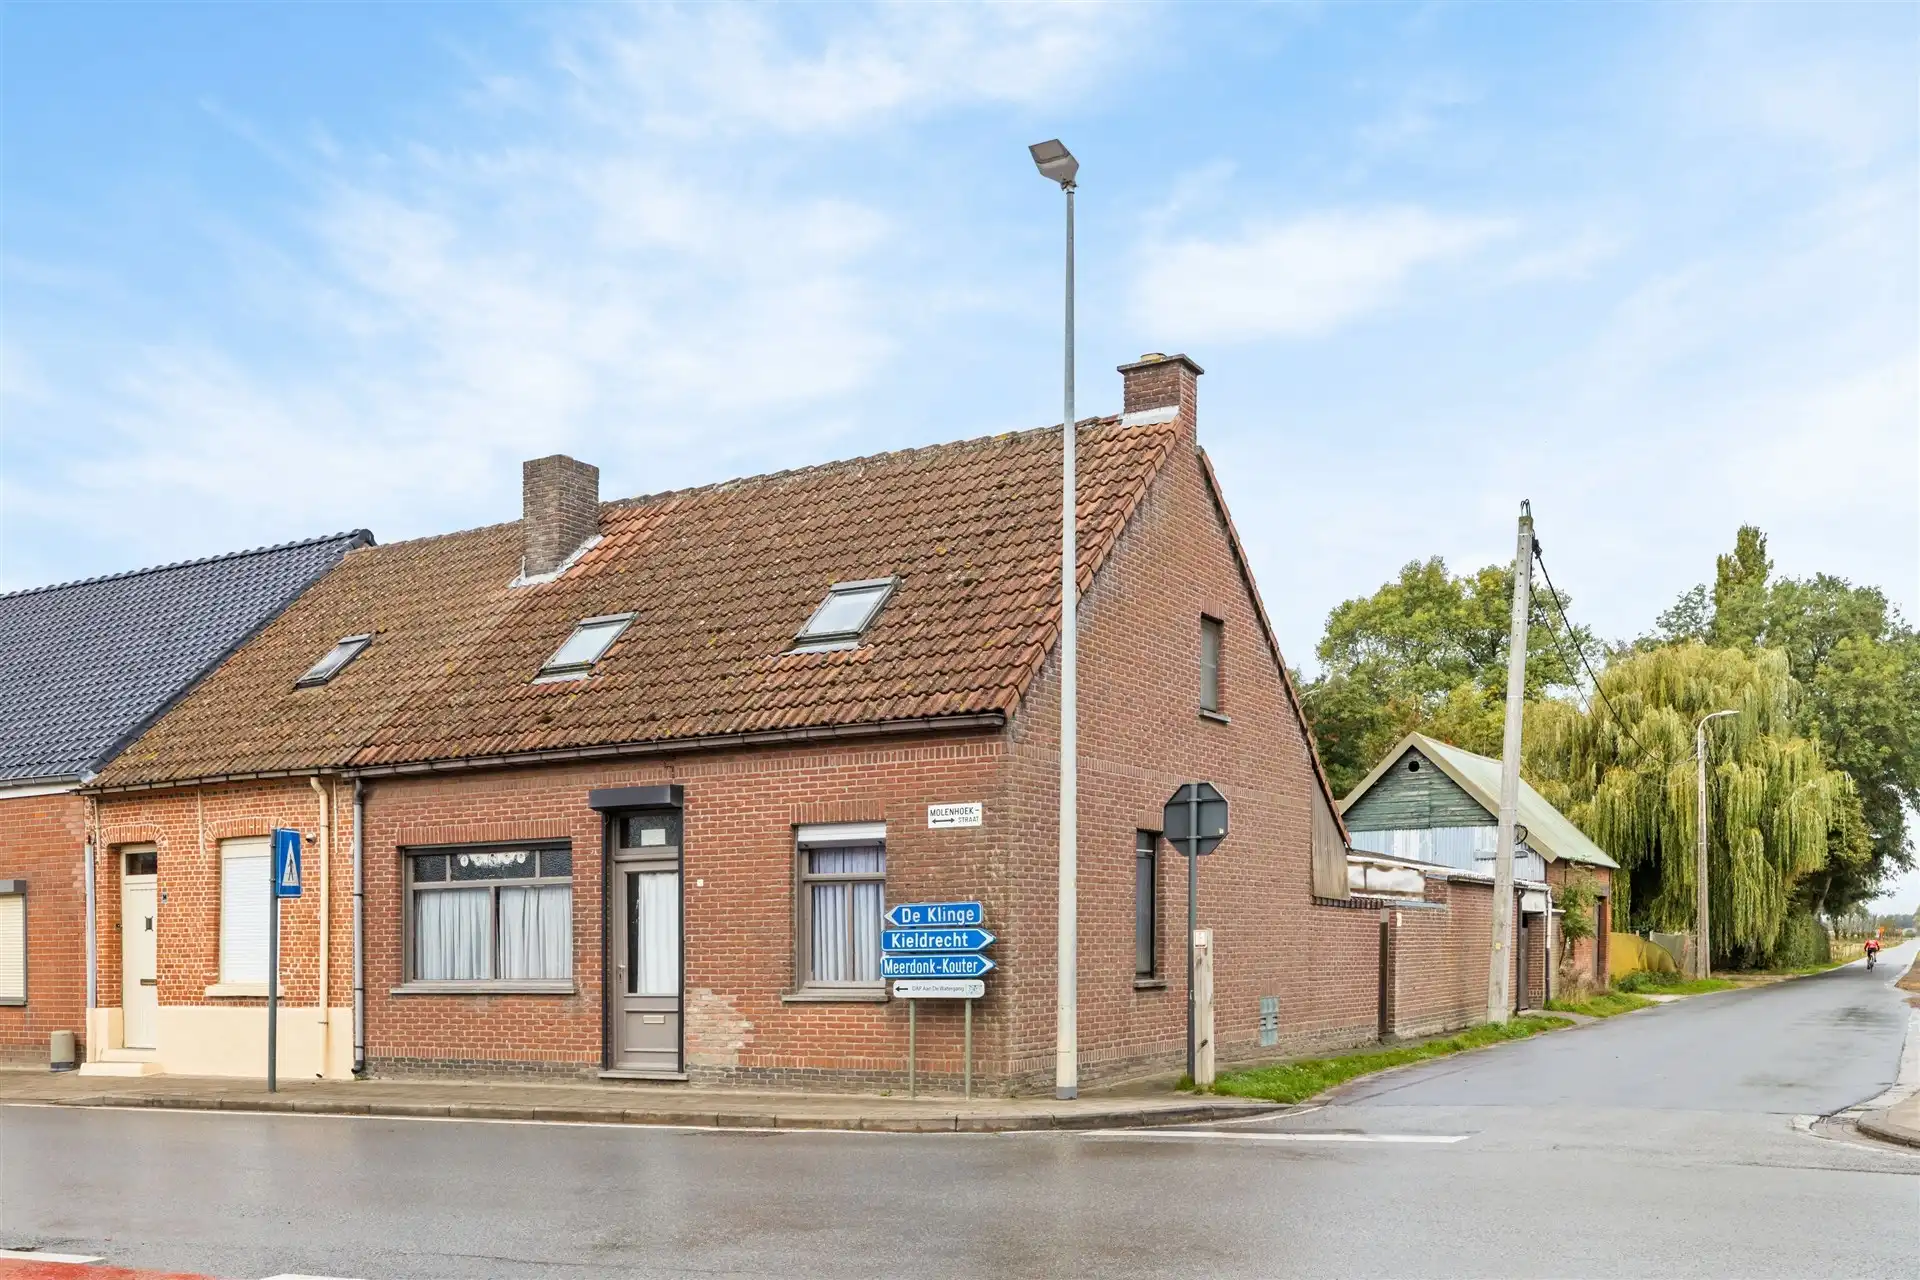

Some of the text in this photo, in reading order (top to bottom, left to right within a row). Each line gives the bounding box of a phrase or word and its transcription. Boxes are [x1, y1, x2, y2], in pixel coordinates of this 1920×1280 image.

[930, 807, 980, 816] MOLENHOEK-
[901, 907, 975, 925] De Klinge
[891, 932, 969, 948] Kieldrecht
[884, 958, 978, 974] Meerdonk-Kouter
